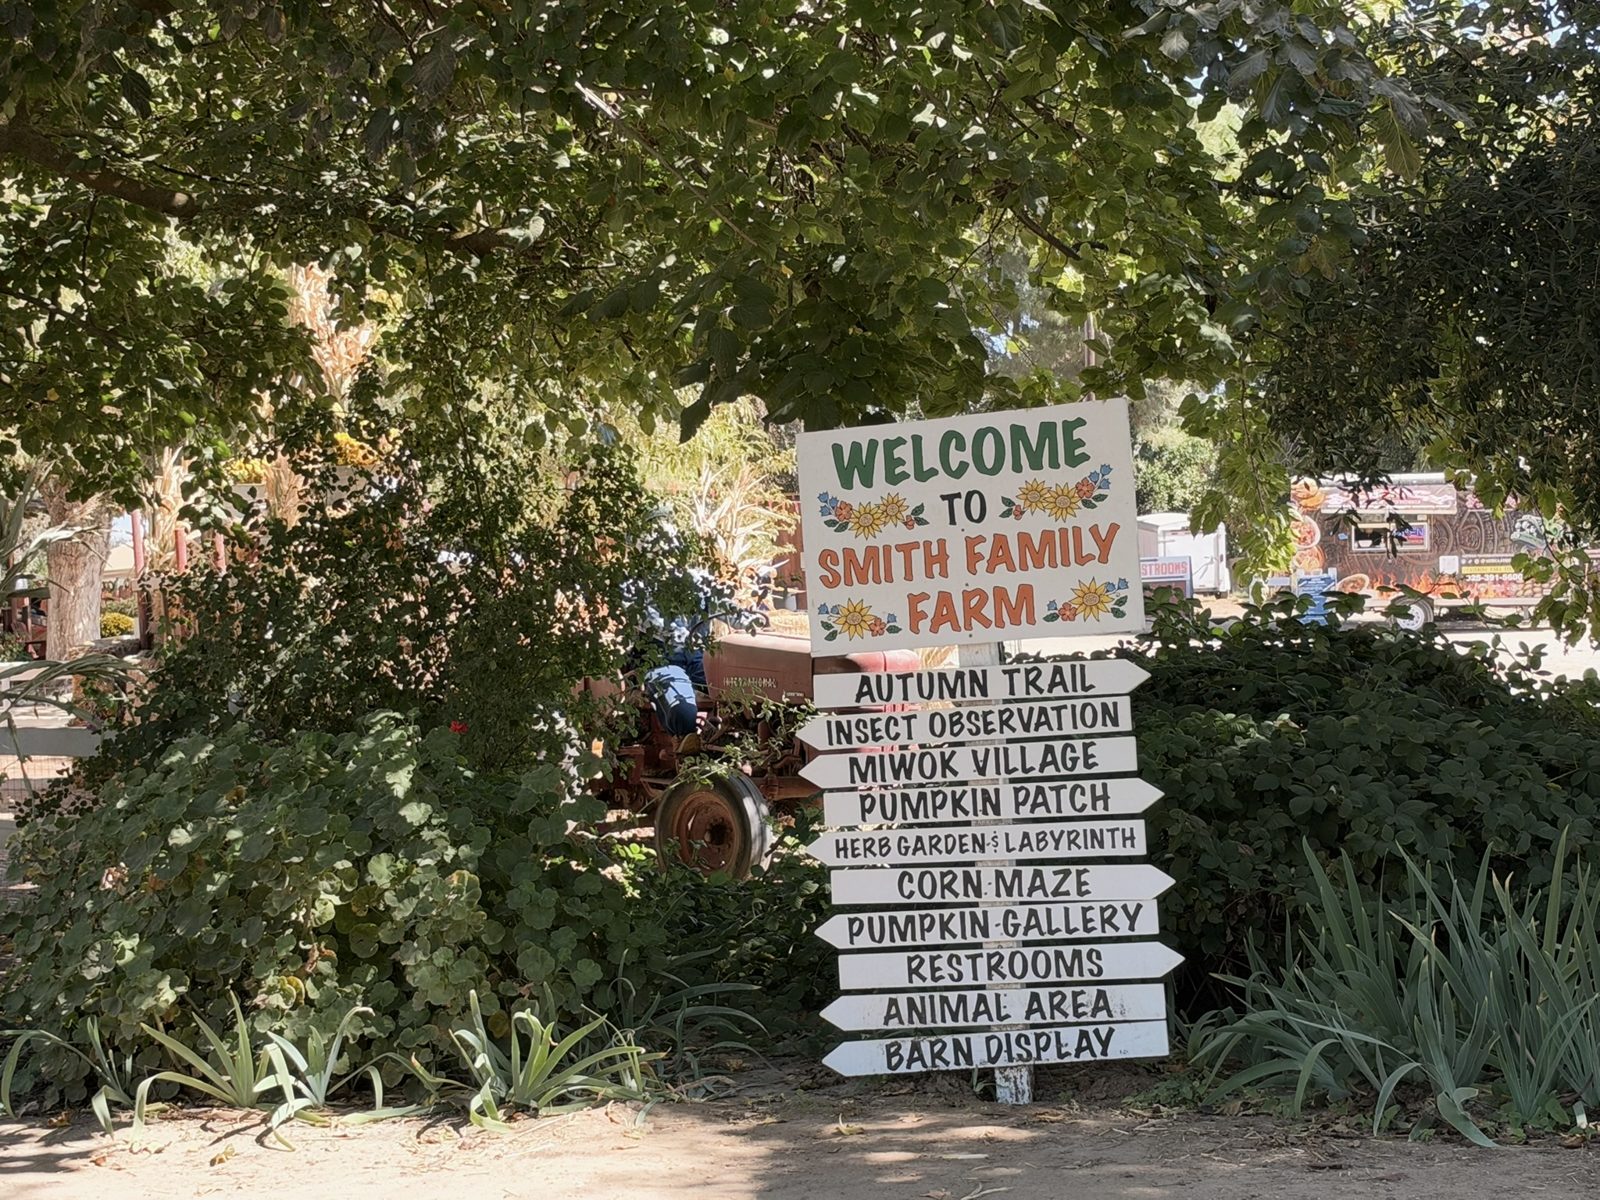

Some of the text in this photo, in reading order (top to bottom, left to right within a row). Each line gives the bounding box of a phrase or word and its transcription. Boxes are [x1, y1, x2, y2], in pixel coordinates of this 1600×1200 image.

[831, 416, 1091, 490] WELCOME
[940, 489, 987, 526] TO
[818, 522, 1120, 589] SMITH FAMILY
[907, 583, 1037, 634] FARM
[855, 664, 1096, 703] AUTUMN TRAIL
[827, 702, 1120, 746] INSECT OBSERVATION
[849, 741, 1099, 785] MIWOK VILLAGE
[860, 781, 1110, 822] PUMPKIN PATCH
[835, 836, 891, 859] HERB
[897, 832, 986, 857] GARDEN
[1005, 826, 1136, 852] LABYRINTH
[897, 868, 1092, 900] CORN MAZE
[847, 902, 1143, 944] PUMPKIN GALLERY
[907, 948, 1104, 983] RESTROOMS
[882, 988, 1113, 1026] ANIMAL AREA
[885, 1027, 1116, 1071] BARN DISPLAY
